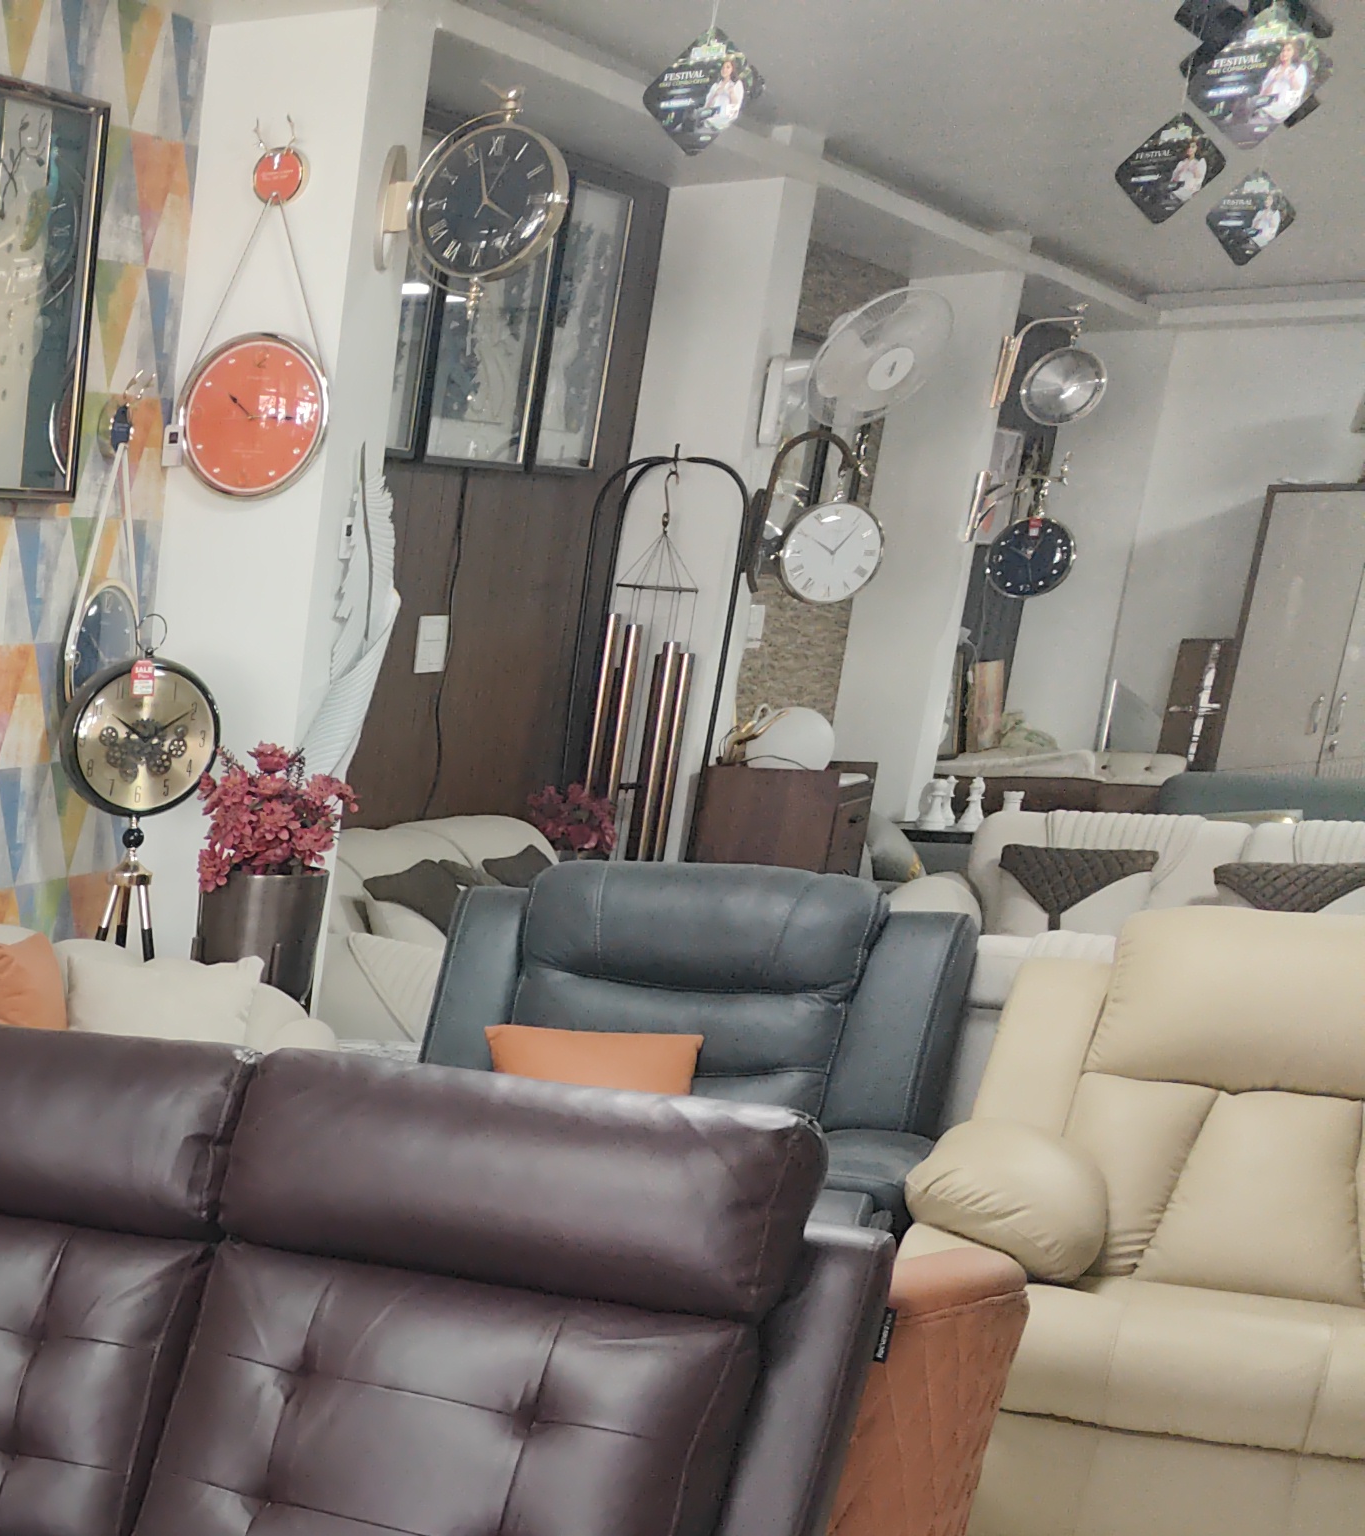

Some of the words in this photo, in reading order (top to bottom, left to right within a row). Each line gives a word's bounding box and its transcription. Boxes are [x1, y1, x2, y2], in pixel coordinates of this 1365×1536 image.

[1213, 54, 1261, 69] FESTIVAL
[663, 70, 705, 82] FESTIVAL
[1135, 150, 1172, 160] FESTIVAL
[135, 666, 154, 674] SALE
[199, 730, 206, 748] 3
[86, 759, 94, 778] 8
[186, 758, 193, 778] 4
[106, 779, 115, 796] 7
[134, 786, 142, 803] 6
[163, 779, 170, 797] 5
